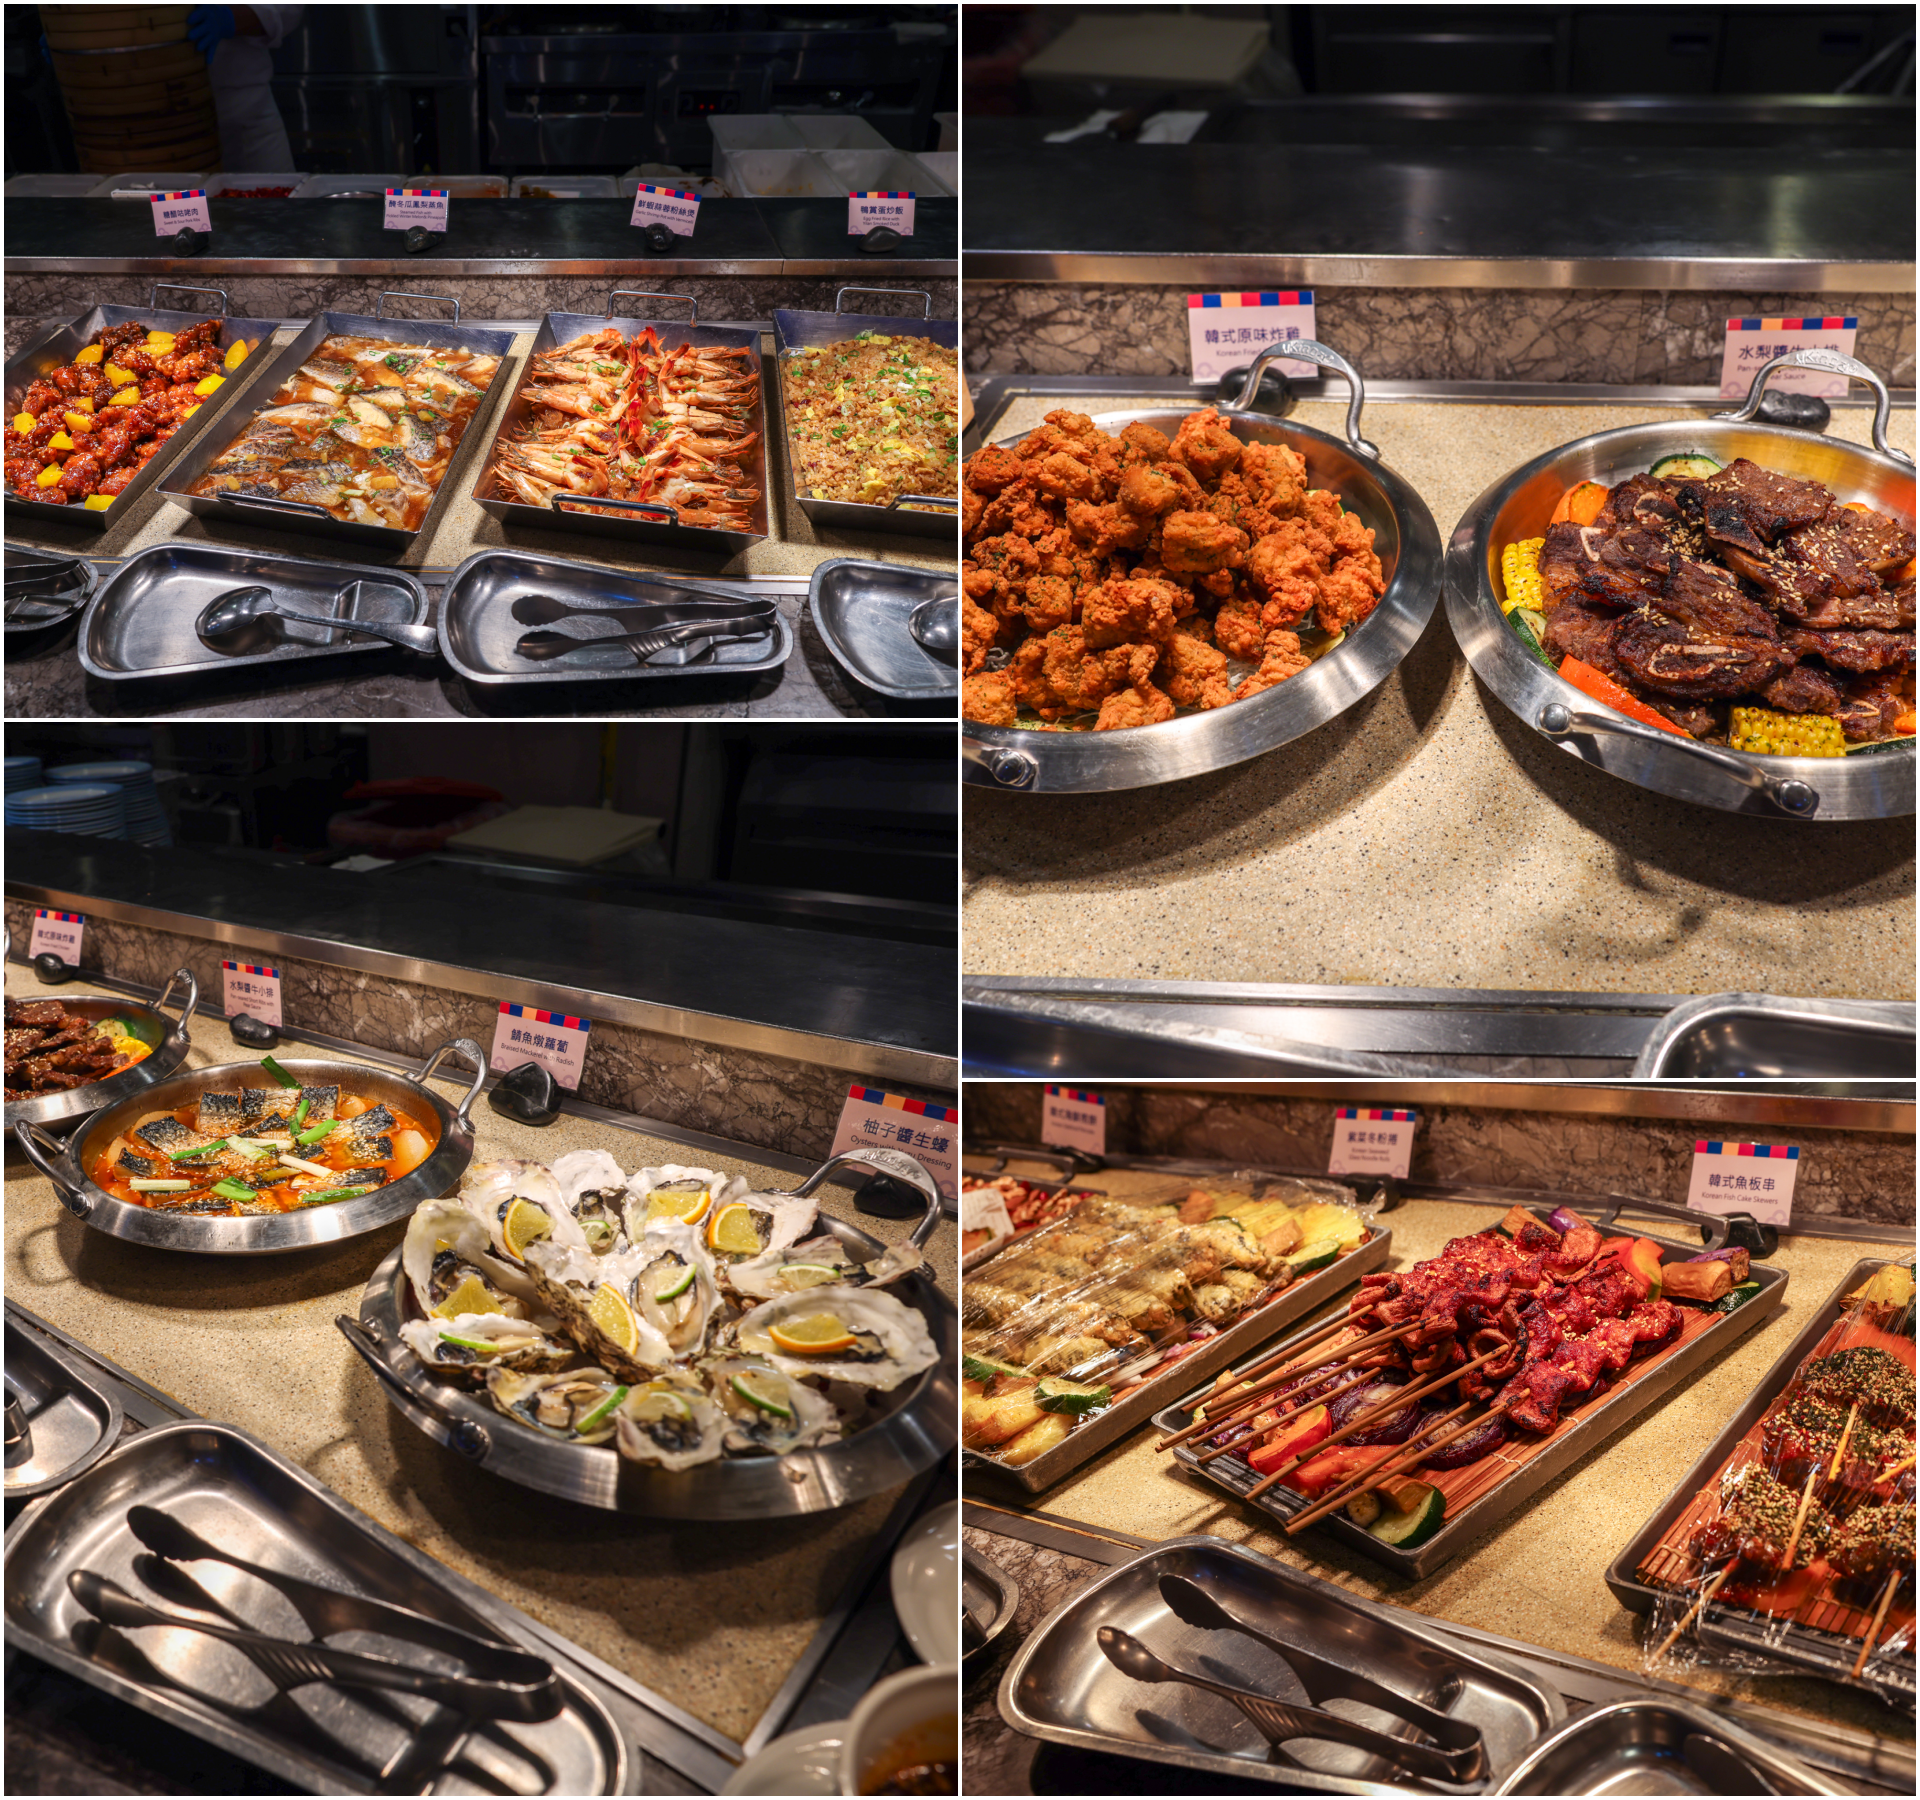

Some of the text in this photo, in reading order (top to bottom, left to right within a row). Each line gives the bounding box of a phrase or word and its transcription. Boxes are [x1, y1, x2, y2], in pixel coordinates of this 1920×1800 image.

[1205, 326, 1300, 344] 韓式原味炸雞
[501, 1043, 520, 1053] Braised
[520, 1048, 542, 1059] Mackerel
[556, 1056, 574, 1066] Radish
[863, 1118, 950, 1154] 柚子醬生蠔
[851, 1135, 878, 1148] Oysters
[917, 1153, 952, 1170] Dressing
[1708, 1173, 1775, 1192] 韓式魚板串
[1724, 1193, 1736, 1201] Fish
[1753, 1196, 1778, 1205] Skewers
